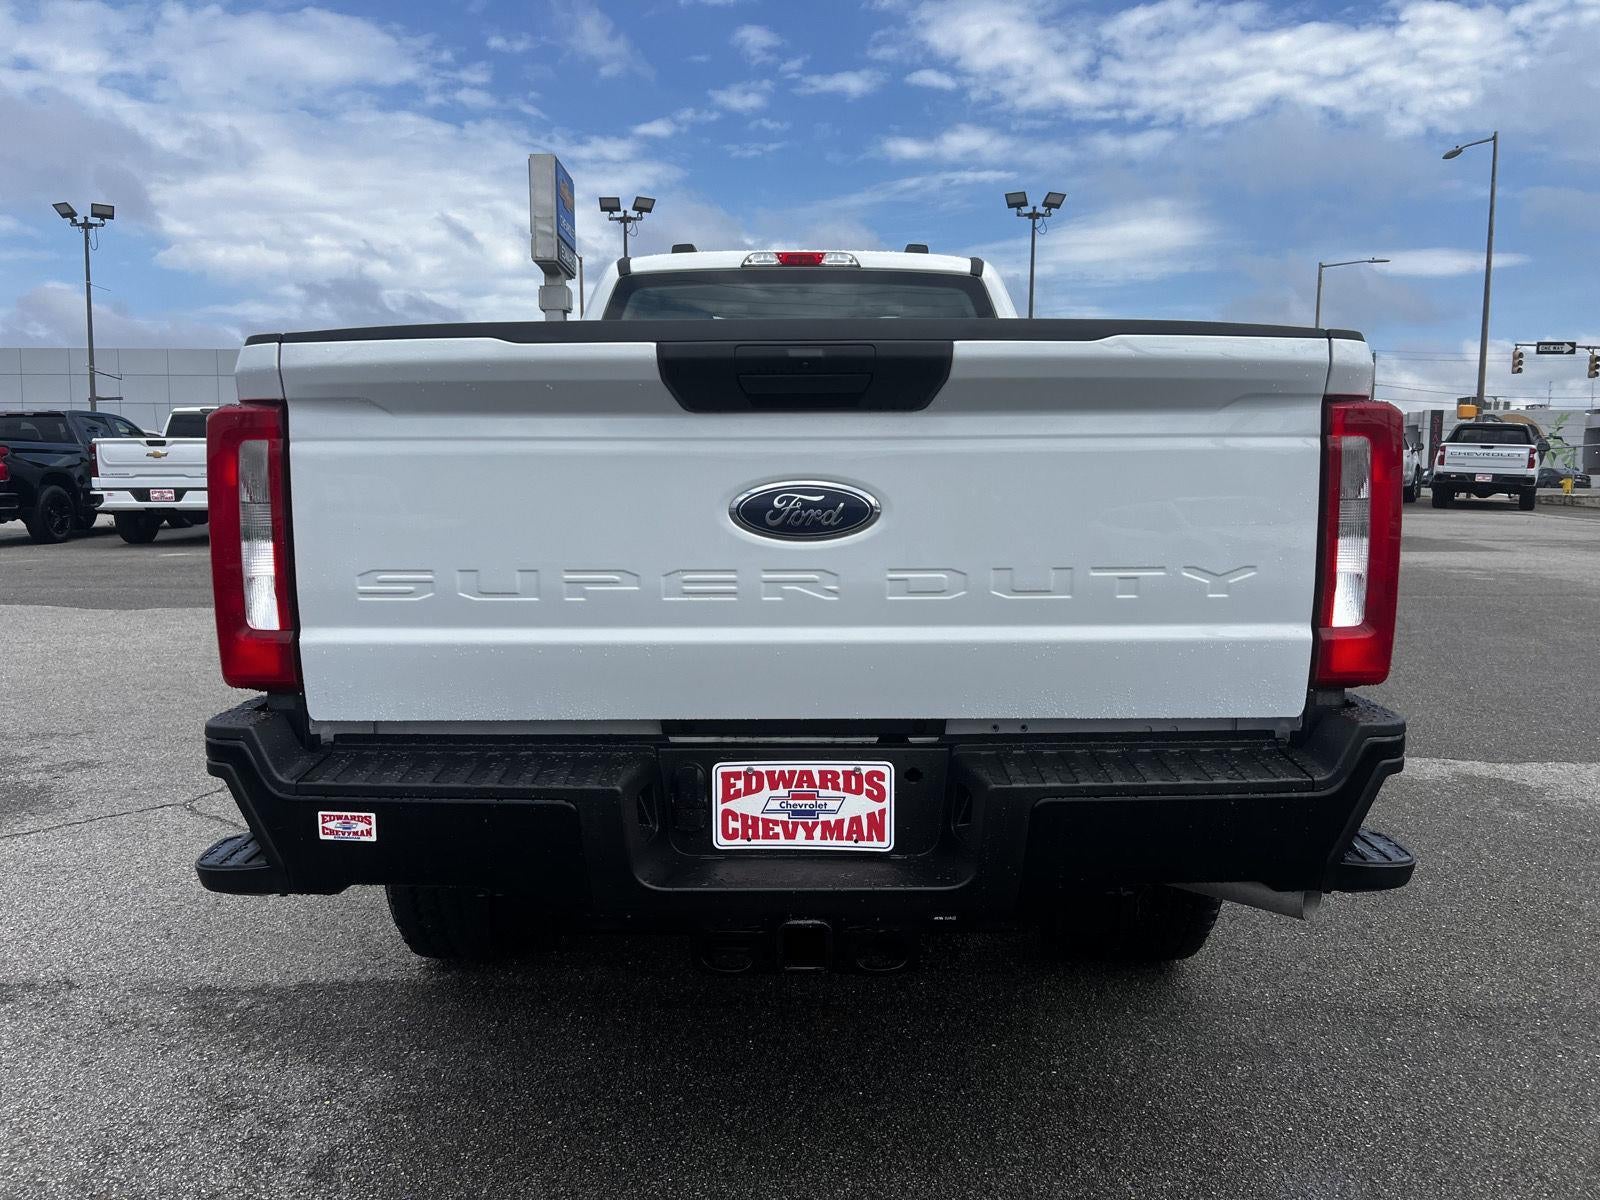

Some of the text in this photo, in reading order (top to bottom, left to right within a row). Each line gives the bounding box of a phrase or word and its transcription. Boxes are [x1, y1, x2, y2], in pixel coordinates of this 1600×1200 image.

[765, 493, 845, 526] Ford
[356, 565, 1257, 601] SUPER DUTY
[721, 769, 887, 804] EDWARDS
[321, 814, 372, 826] EDWARDS
[779, 800, 828, 810] Chevrolet
[321, 826, 372, 837] CHEVYMAN
[721, 807, 887, 842] CHEVYMAN
